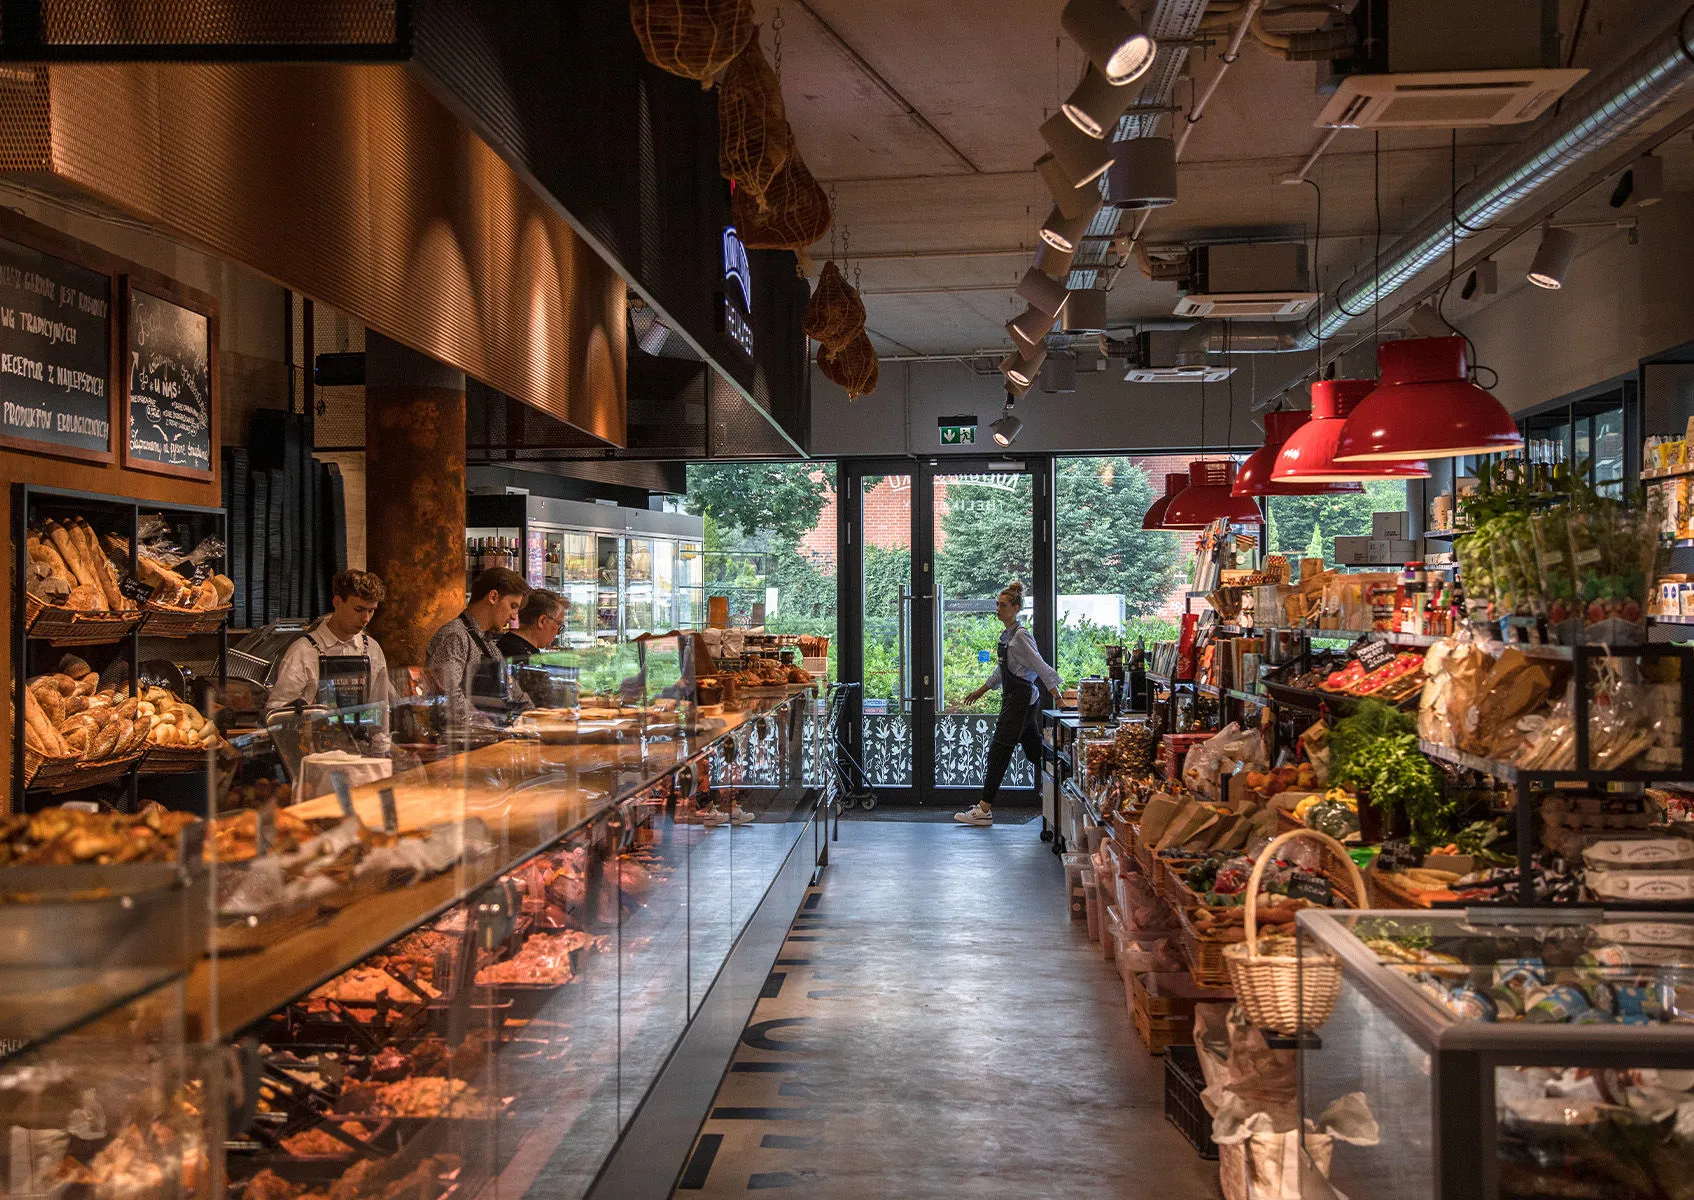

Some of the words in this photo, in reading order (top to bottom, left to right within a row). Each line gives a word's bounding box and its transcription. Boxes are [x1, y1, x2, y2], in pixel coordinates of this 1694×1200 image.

[59, 284, 76, 308] JEST
[1, 306, 15, 329] WG
[1, 353, 43, 382] RECEPTUR
[48, 364, 54, 384] Z
